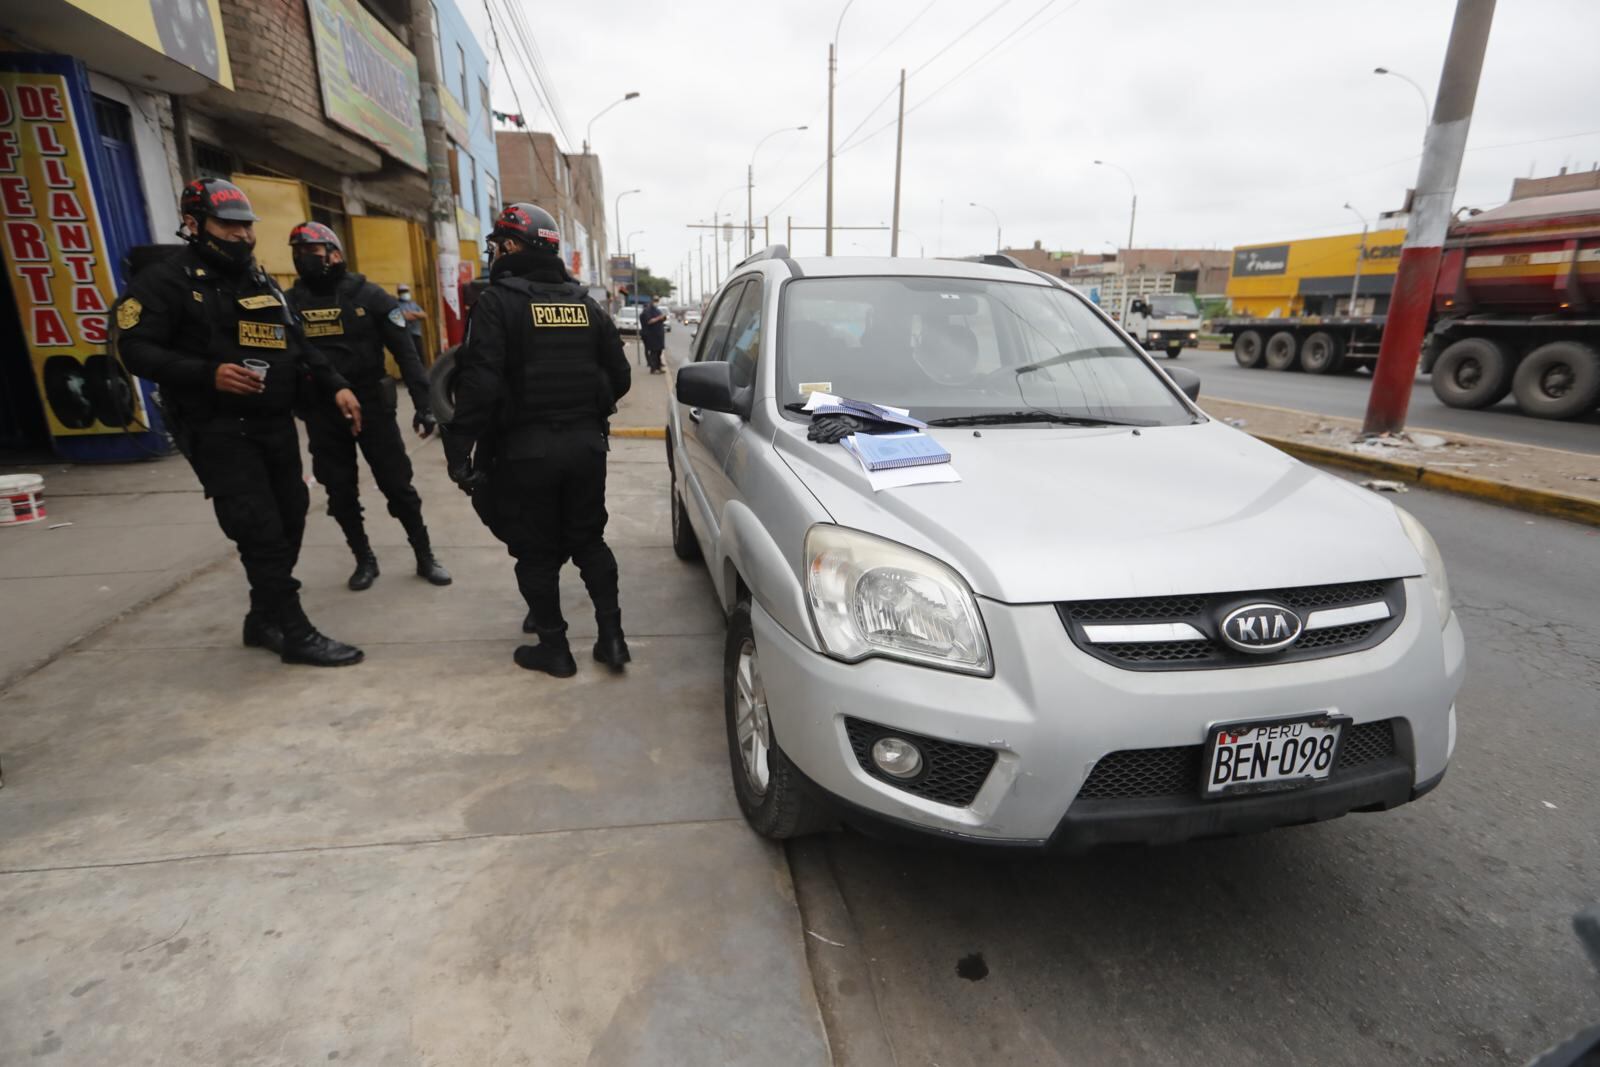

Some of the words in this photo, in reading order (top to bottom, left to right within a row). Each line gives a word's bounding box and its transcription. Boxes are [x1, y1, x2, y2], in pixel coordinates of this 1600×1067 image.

[16, 84, 65, 120] DE
[33, 123, 109, 343] LLANTAS
[535, 306, 587, 323] POLICIA
[1237, 614, 1291, 640] KIA
[1256, 725, 1303, 741] PERU
[1213, 734, 1334, 785] BEN-098
